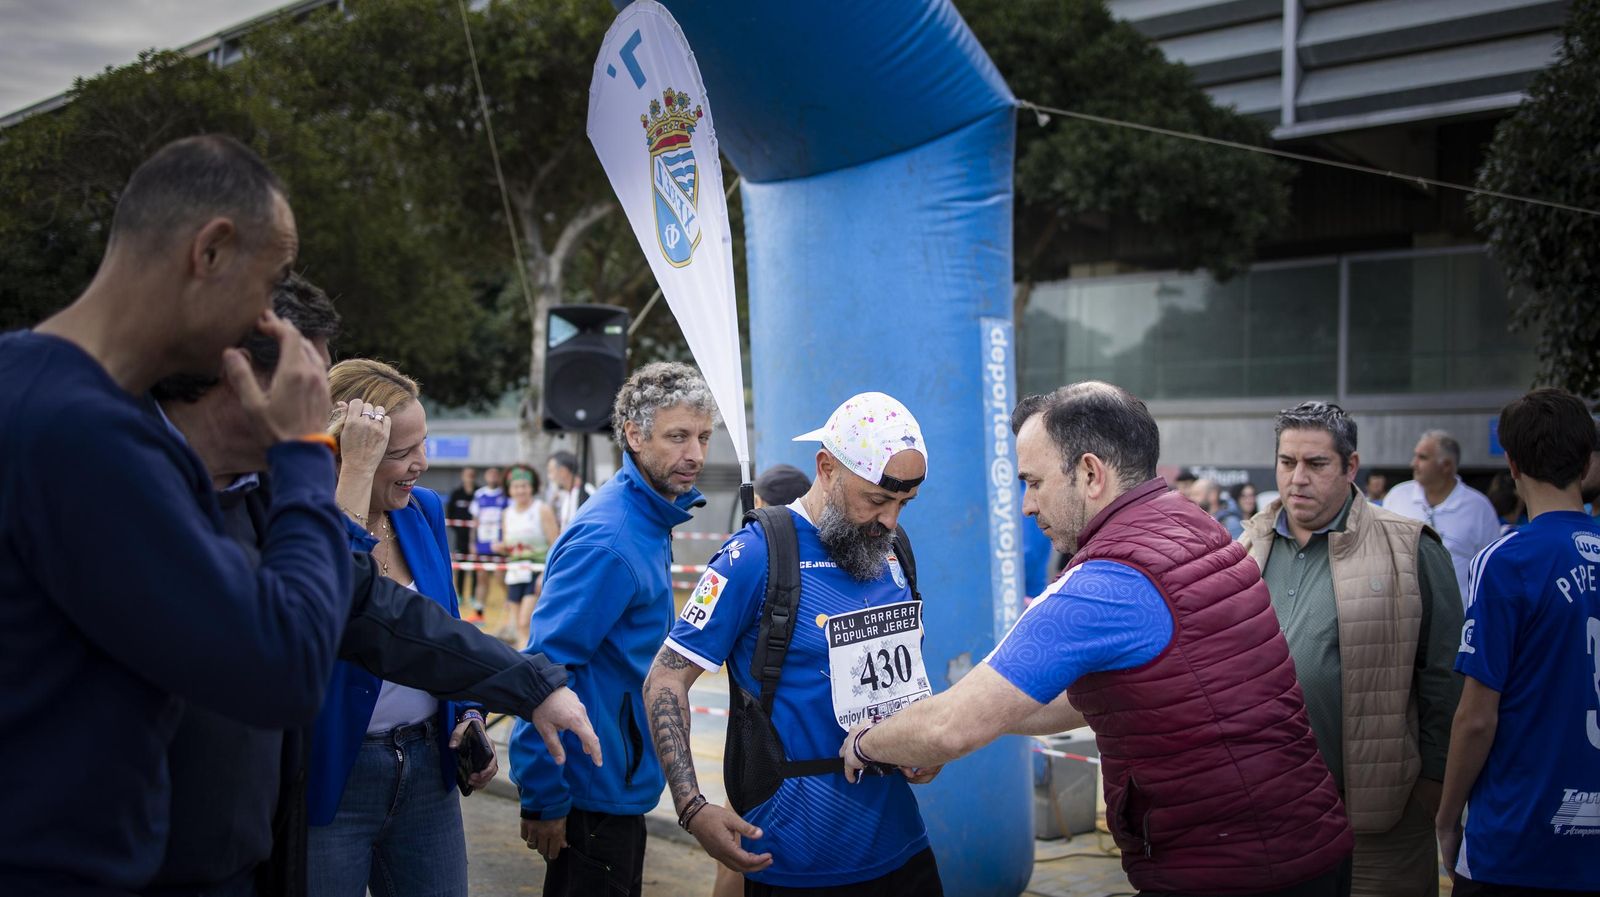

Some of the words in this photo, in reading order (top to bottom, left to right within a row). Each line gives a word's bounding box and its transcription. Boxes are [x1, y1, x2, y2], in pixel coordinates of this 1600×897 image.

[1556, 565, 1597, 604] PEPE
[682, 602, 706, 624] LFP
[863, 606, 915, 625] CARRERA
[835, 626, 878, 644] POPULAR
[883, 618, 916, 633] JEREZ
[860, 644, 912, 691] 430
